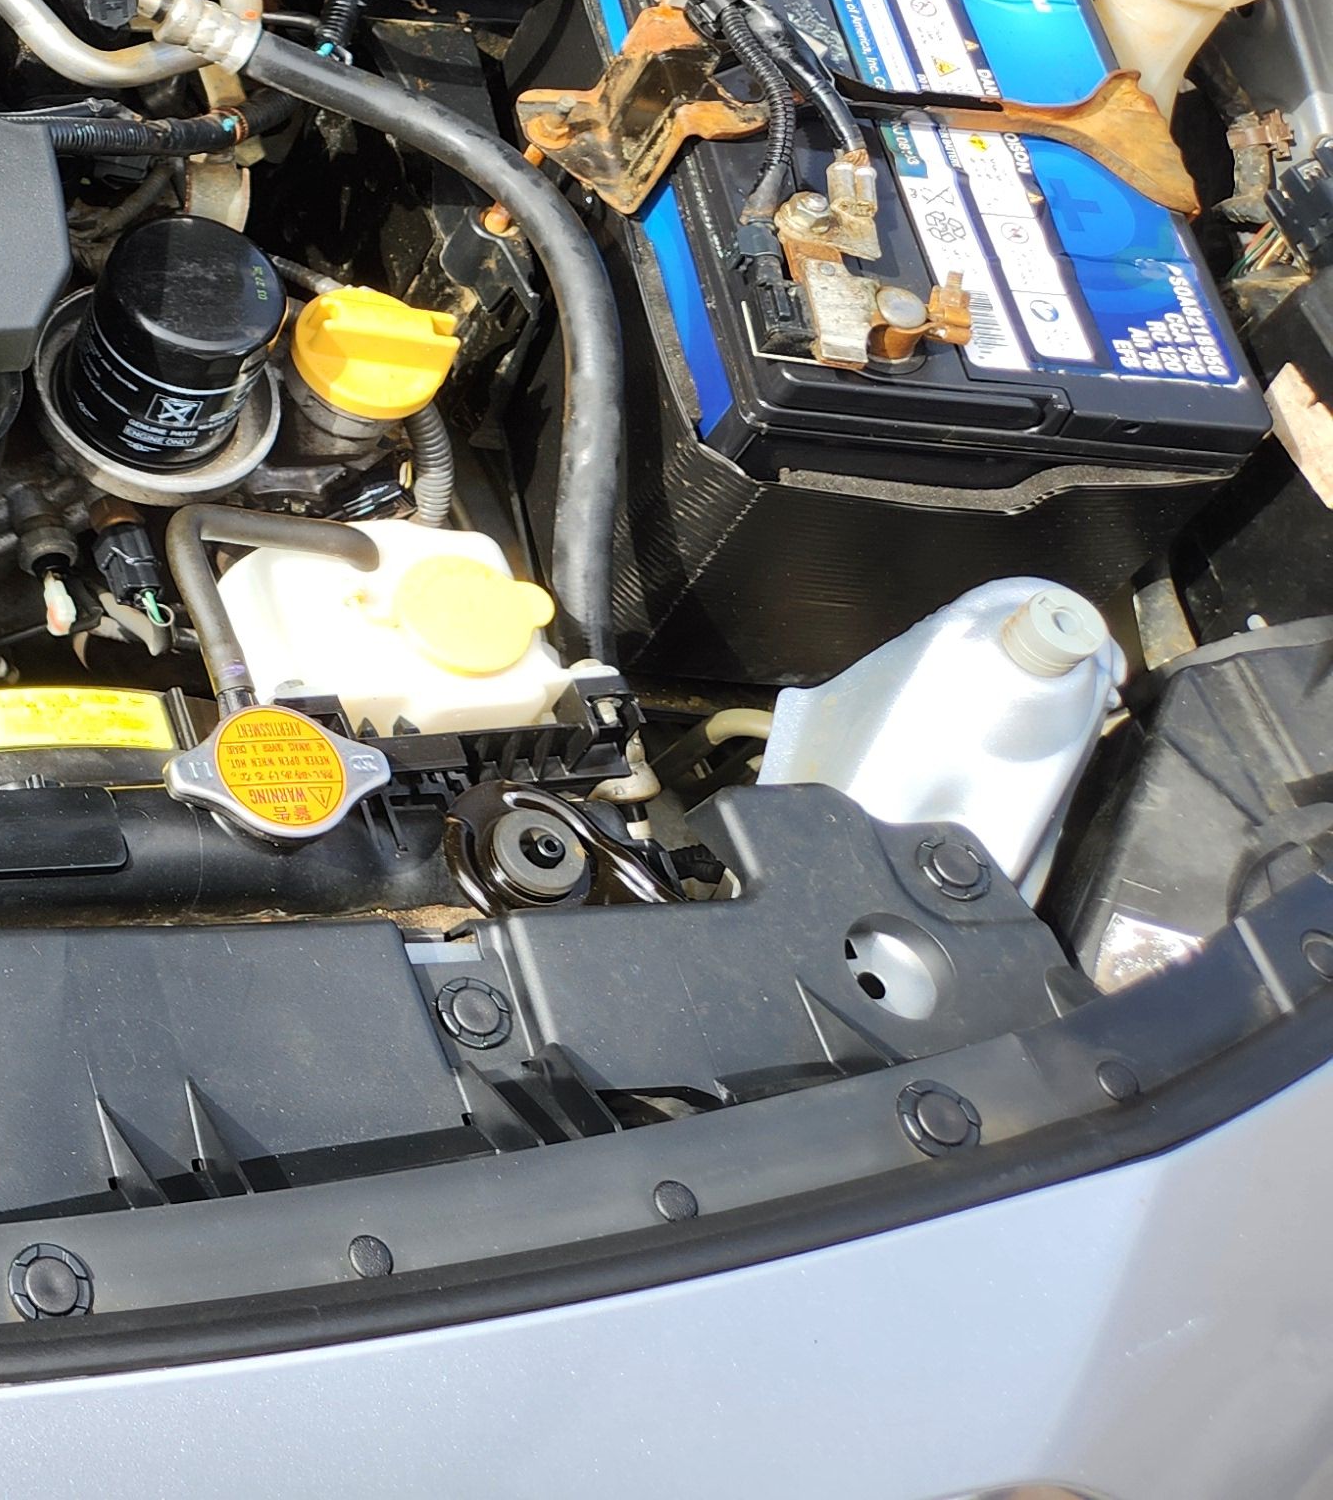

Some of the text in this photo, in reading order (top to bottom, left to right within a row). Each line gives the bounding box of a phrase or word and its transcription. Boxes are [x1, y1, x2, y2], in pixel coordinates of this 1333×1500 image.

[846, 3, 860, 14] of
[976, 69, 1033, 175] DAN OISON
[1127, 326, 1153, 348] Ah
[1145, 320, 1185, 373] RC 120
[1163, 312, 1207, 374] CCA 750
[1111, 339, 1142, 369] EFB
[125, 426, 193, 446] ENGINE ONLY
[128, 418, 199, 438] GENUINE PARTS
[250, 756, 275, 767] WHEN
[277, 755, 301, 766] OPEN
[305, 754, 331, 766] NEVER
[248, 786, 309, 805] WARNING
[273, 804, 312, 821] 警告
